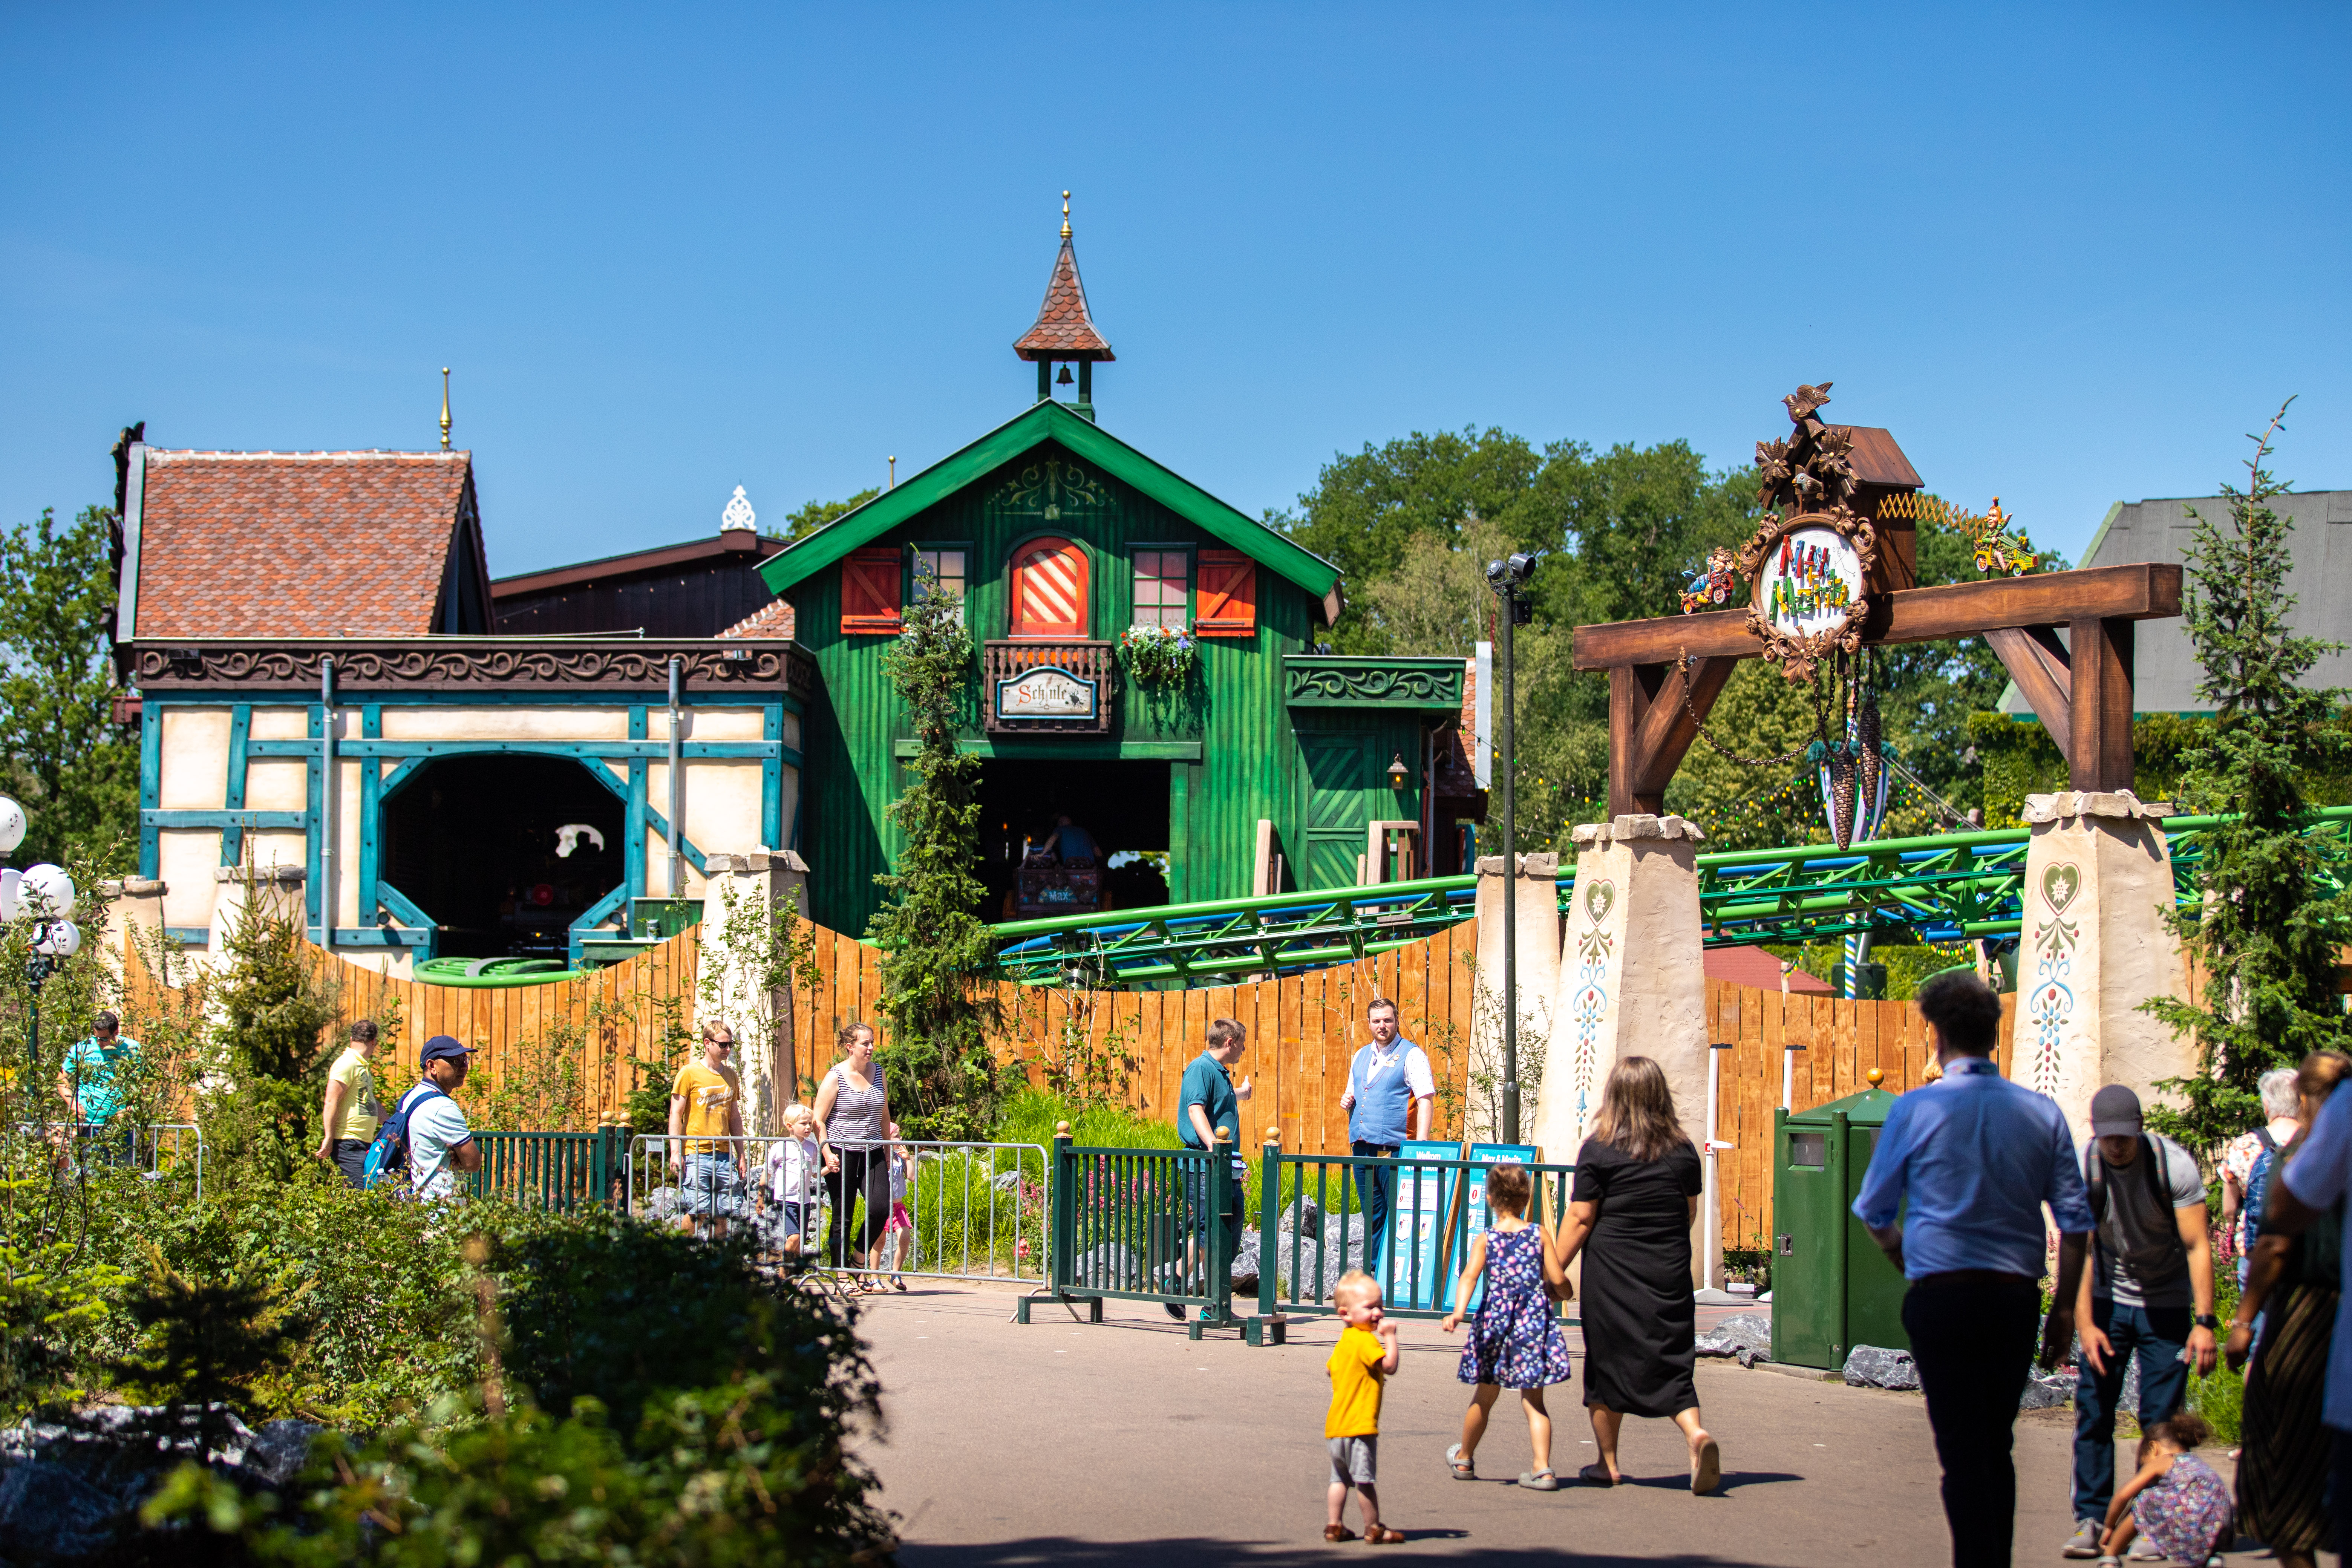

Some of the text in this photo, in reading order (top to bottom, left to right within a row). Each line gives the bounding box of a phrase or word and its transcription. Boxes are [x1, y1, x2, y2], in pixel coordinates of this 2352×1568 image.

[1016, 684, 1067, 706] Schule
[1049, 891, 1069, 902] Max
[1416, 1151, 1441, 1160] Welkom
[1481, 1154, 1495, 1162] Max
